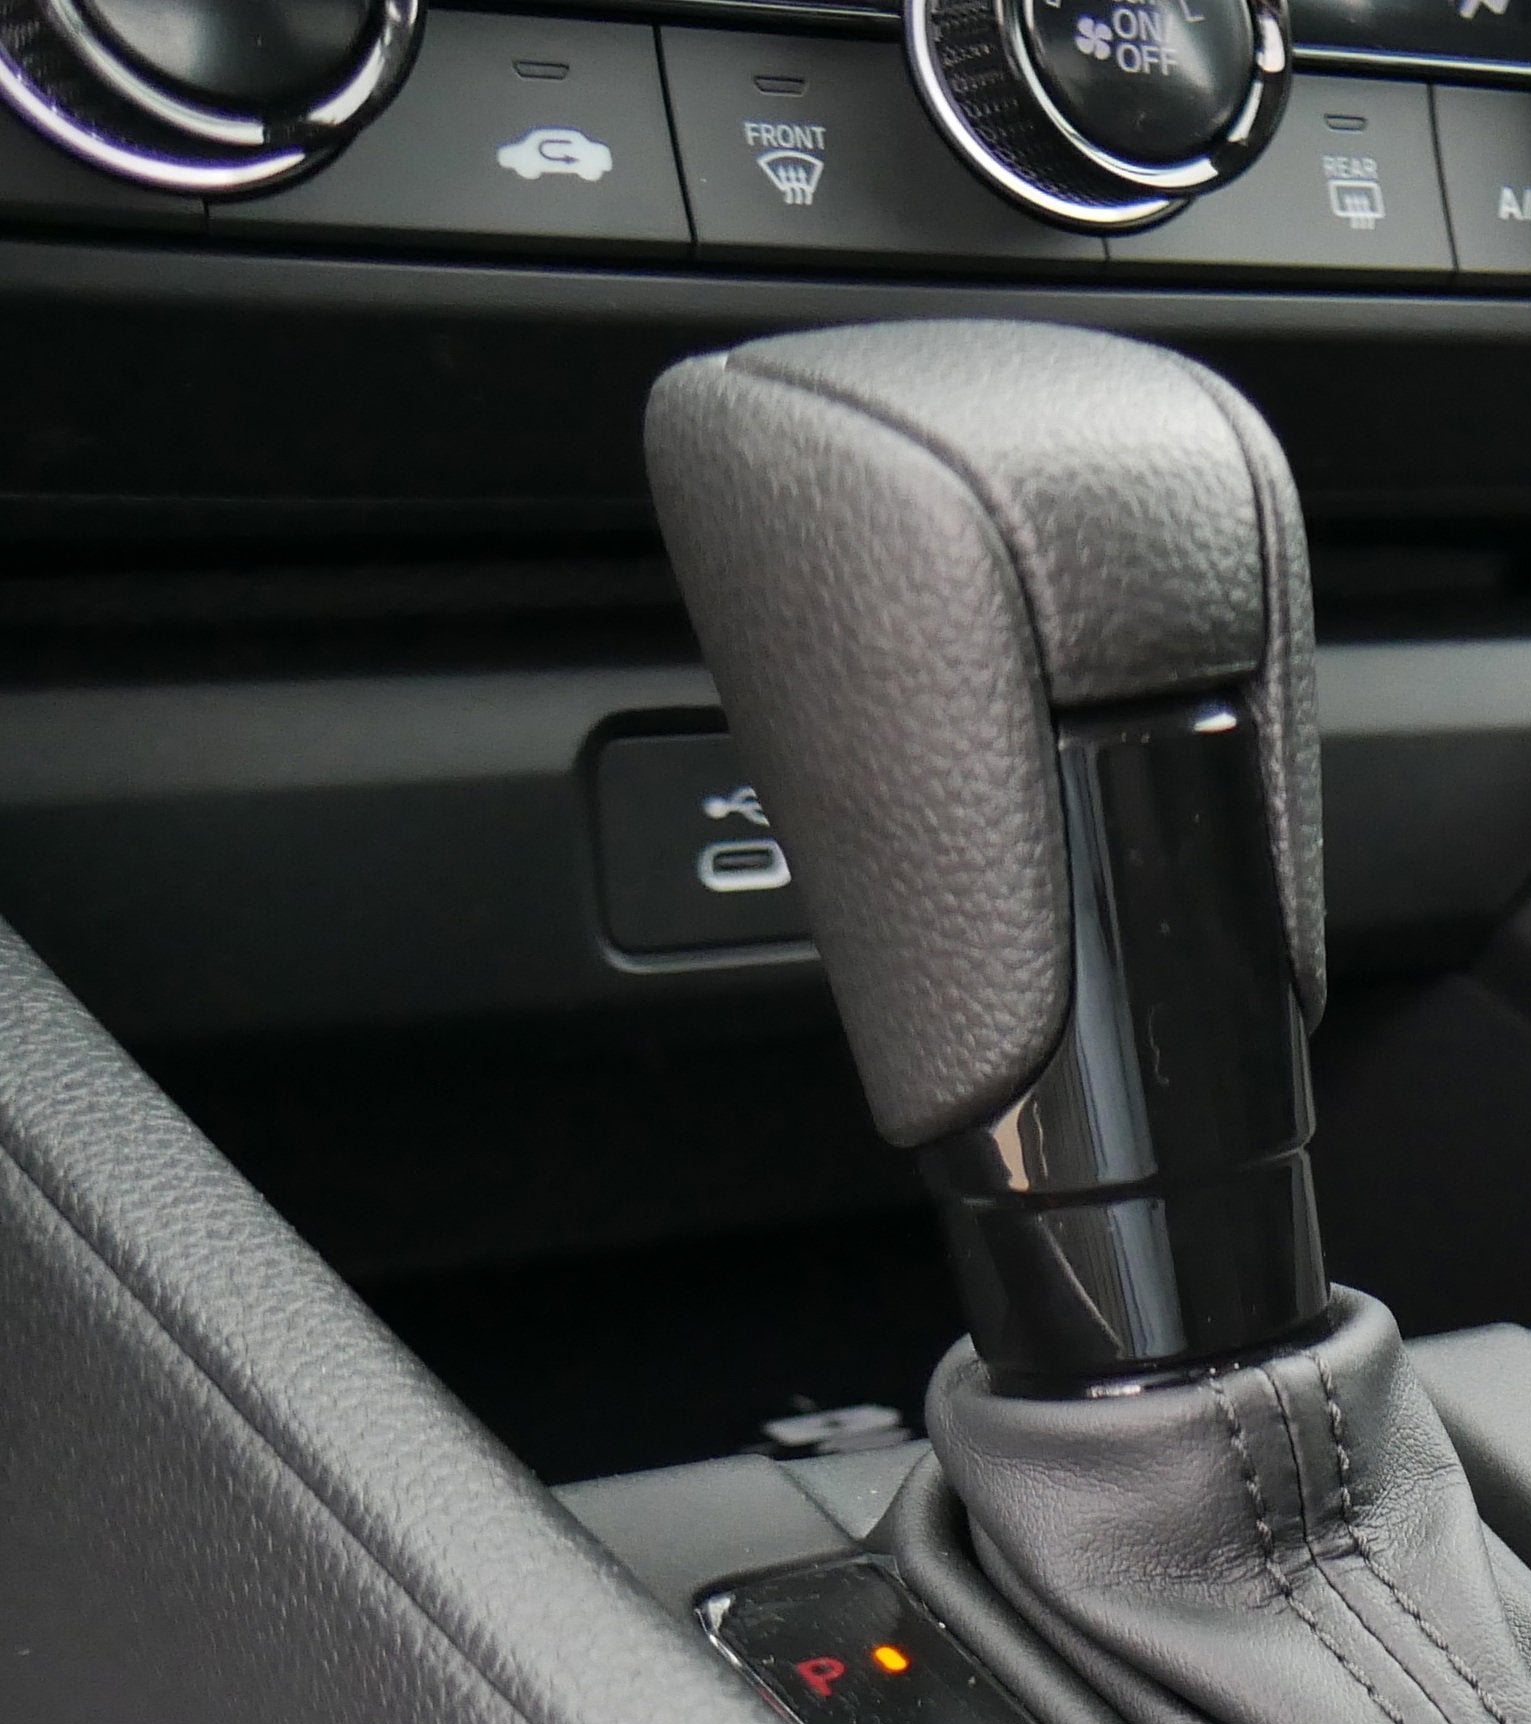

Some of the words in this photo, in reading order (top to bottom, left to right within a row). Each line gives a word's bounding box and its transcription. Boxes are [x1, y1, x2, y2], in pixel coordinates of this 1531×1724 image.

[1116, 44, 1180, 76] OFF
[744, 121, 826, 150] FRONT
[1322, 155, 1379, 179] REAR
[797, 1657, 846, 1697] P
